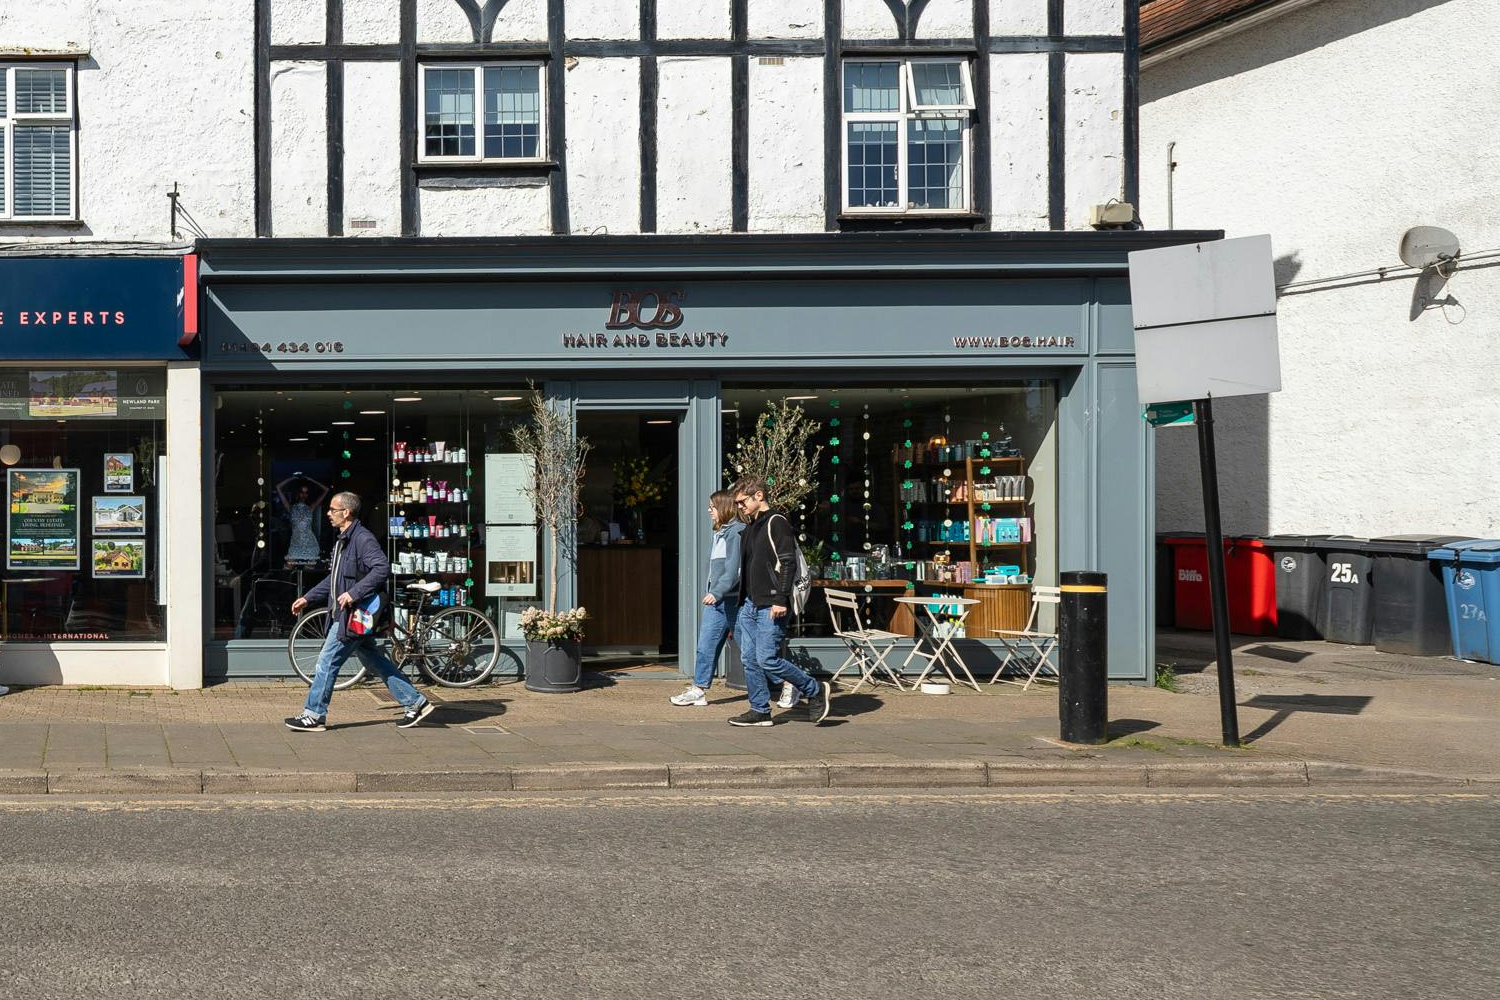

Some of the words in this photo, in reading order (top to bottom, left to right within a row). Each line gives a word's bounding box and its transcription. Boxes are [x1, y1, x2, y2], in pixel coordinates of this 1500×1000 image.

[605, 288, 685, 331] BOS
[19, 311, 125, 325] EXPERTS
[561, 332, 608, 348] HAIR
[612, 333, 650, 348] AND
[654, 331, 729, 348] BEAUTY
[952, 336, 1075, 348] WWW.BOS.HAIR
[276, 342, 310, 353] 434
[1178, 568, 1203, 582] Biffa
[1330, 562, 1360, 584] 25A
[1460, 603, 1486, 622] 27A
